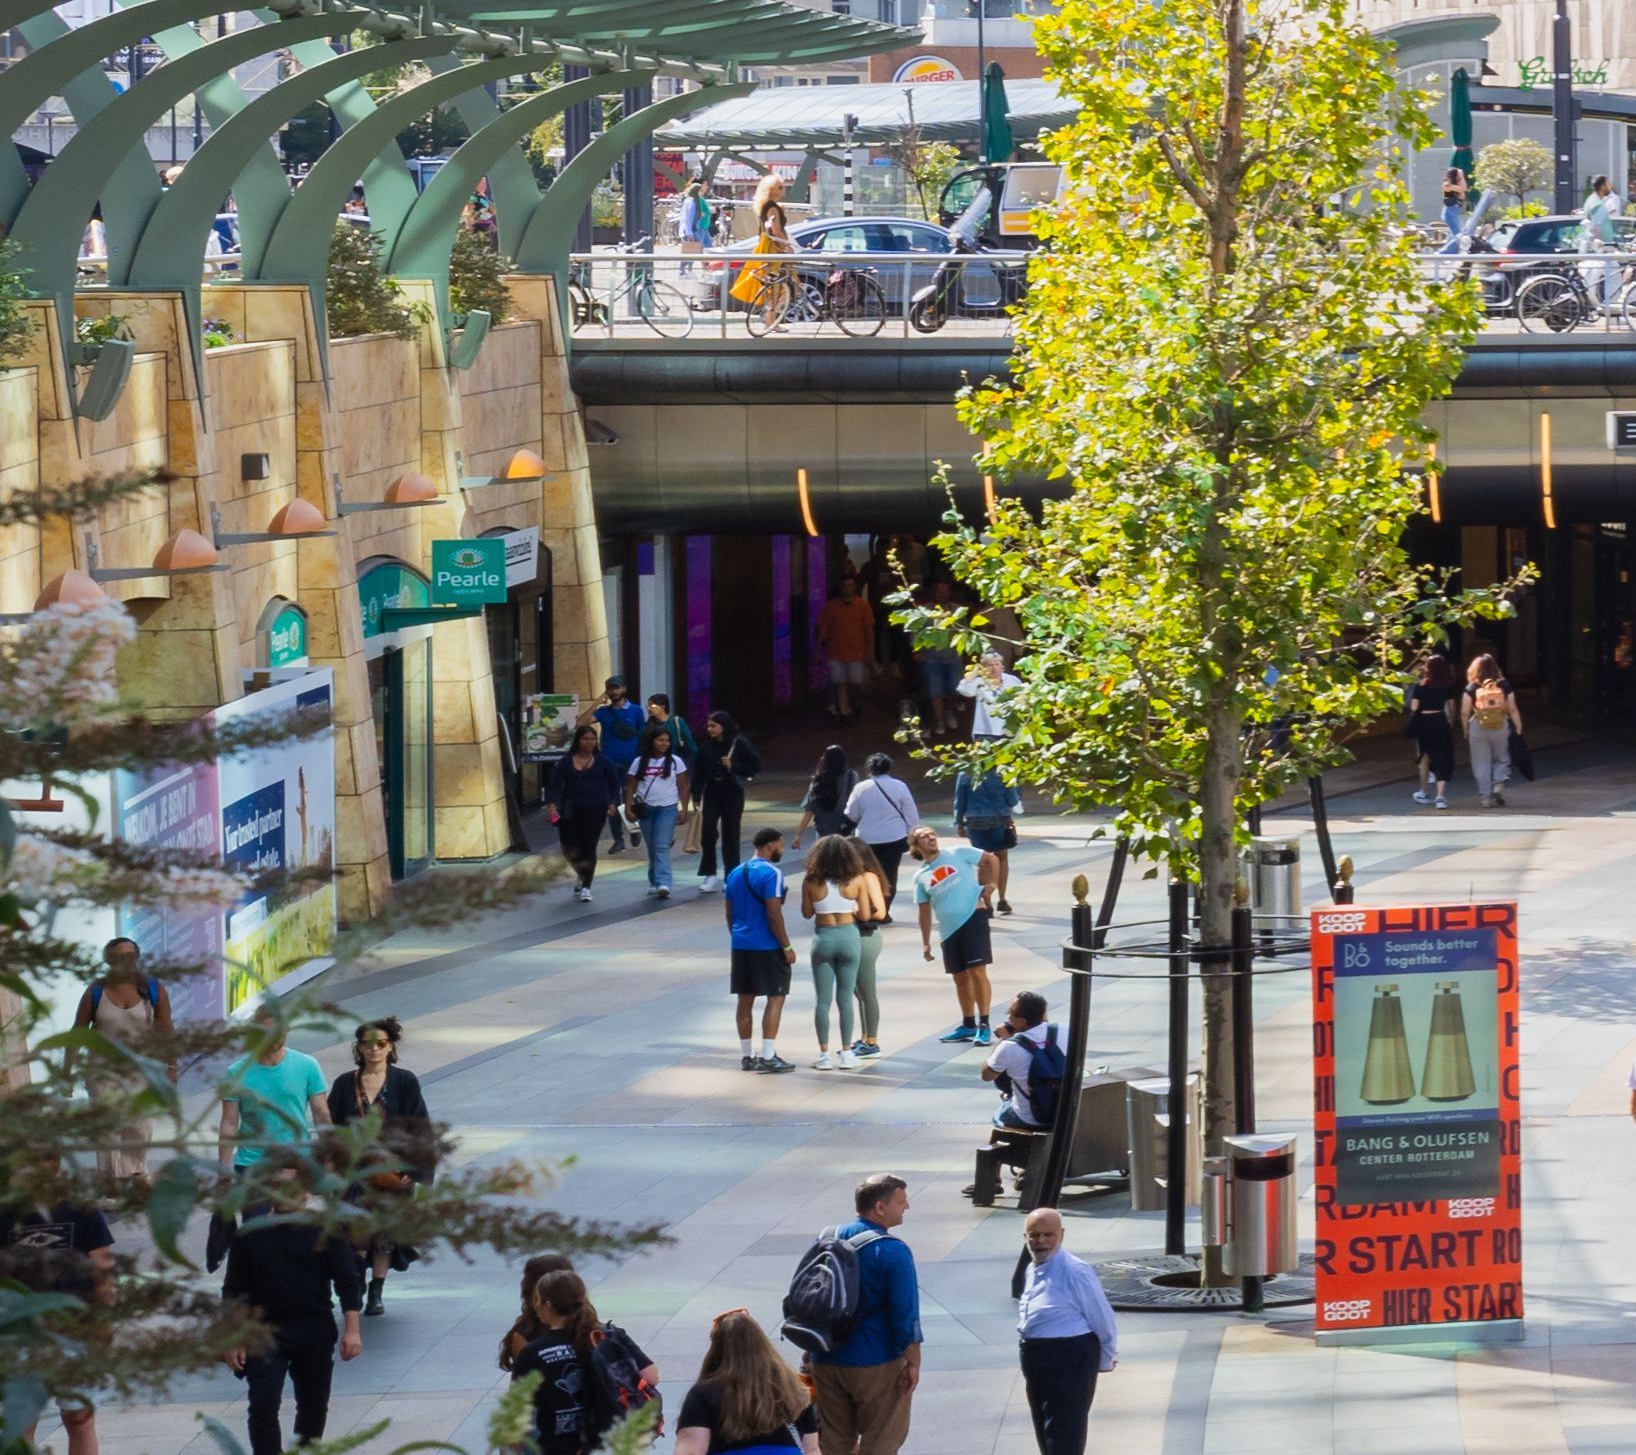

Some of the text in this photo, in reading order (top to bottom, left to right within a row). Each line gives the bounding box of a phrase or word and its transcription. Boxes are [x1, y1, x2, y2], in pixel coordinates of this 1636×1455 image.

[437, 571, 500, 587] Pearle
[1385, 937, 1479, 954] Sounds better
[1385, 953, 1447, 970] together.
[1346, 1131, 1490, 1152] BANG & OLUFSEN
[1360, 1149, 1475, 1166] CENTER ROTTERDAM
[1348, 1229, 1484, 1275] START
[1382, 1287, 1432, 1326] HIER
